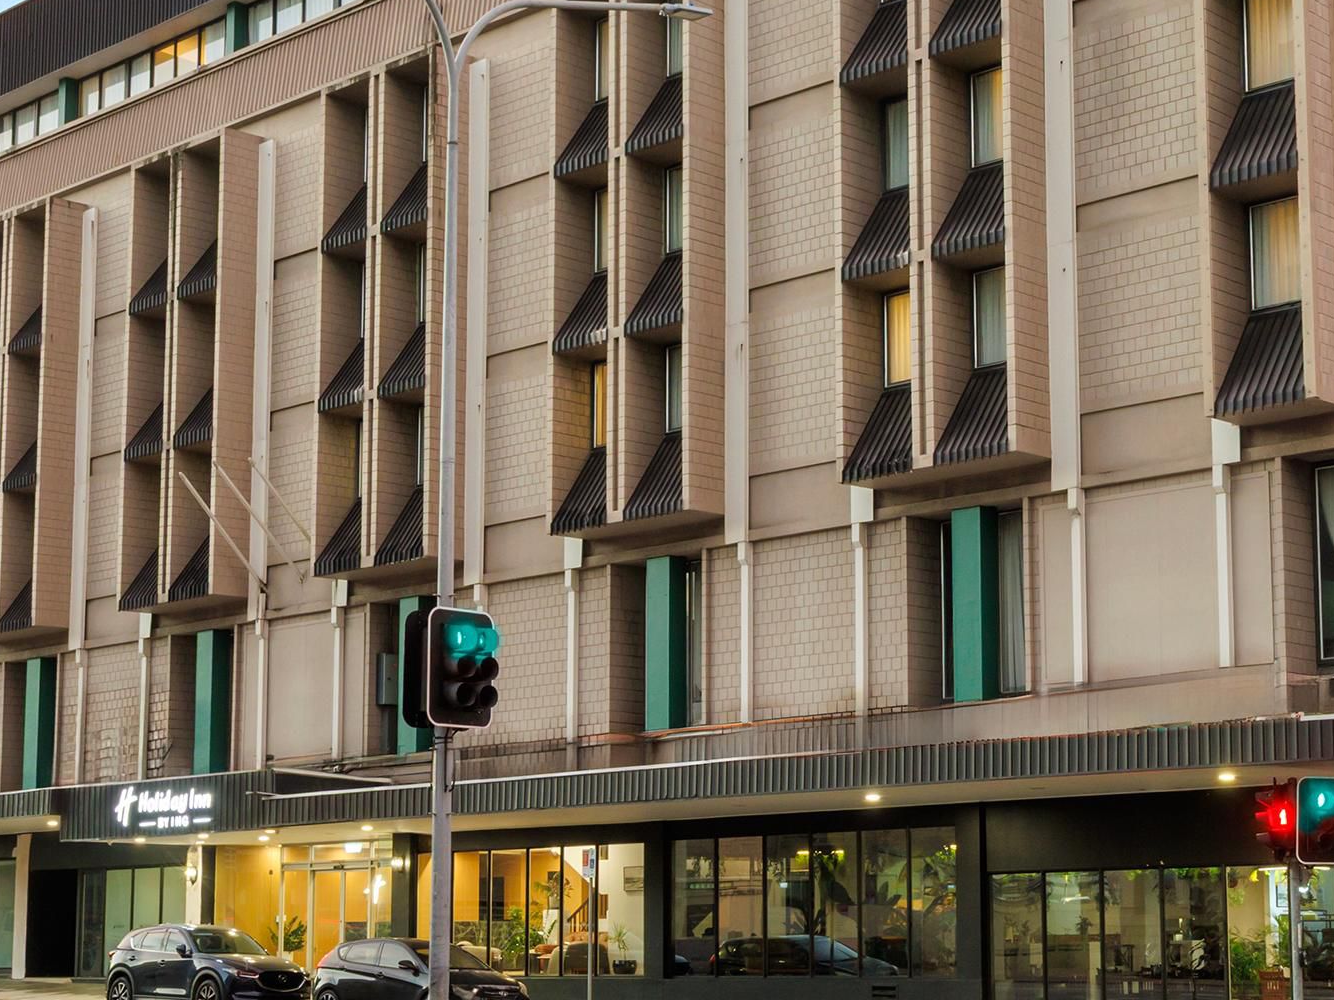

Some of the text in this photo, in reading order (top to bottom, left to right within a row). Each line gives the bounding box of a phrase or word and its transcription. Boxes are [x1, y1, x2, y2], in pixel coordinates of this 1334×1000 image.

[138, 788, 189, 814] Holiday
[189, 787, 212, 810] Inn
[157, 816, 170, 829] BY
